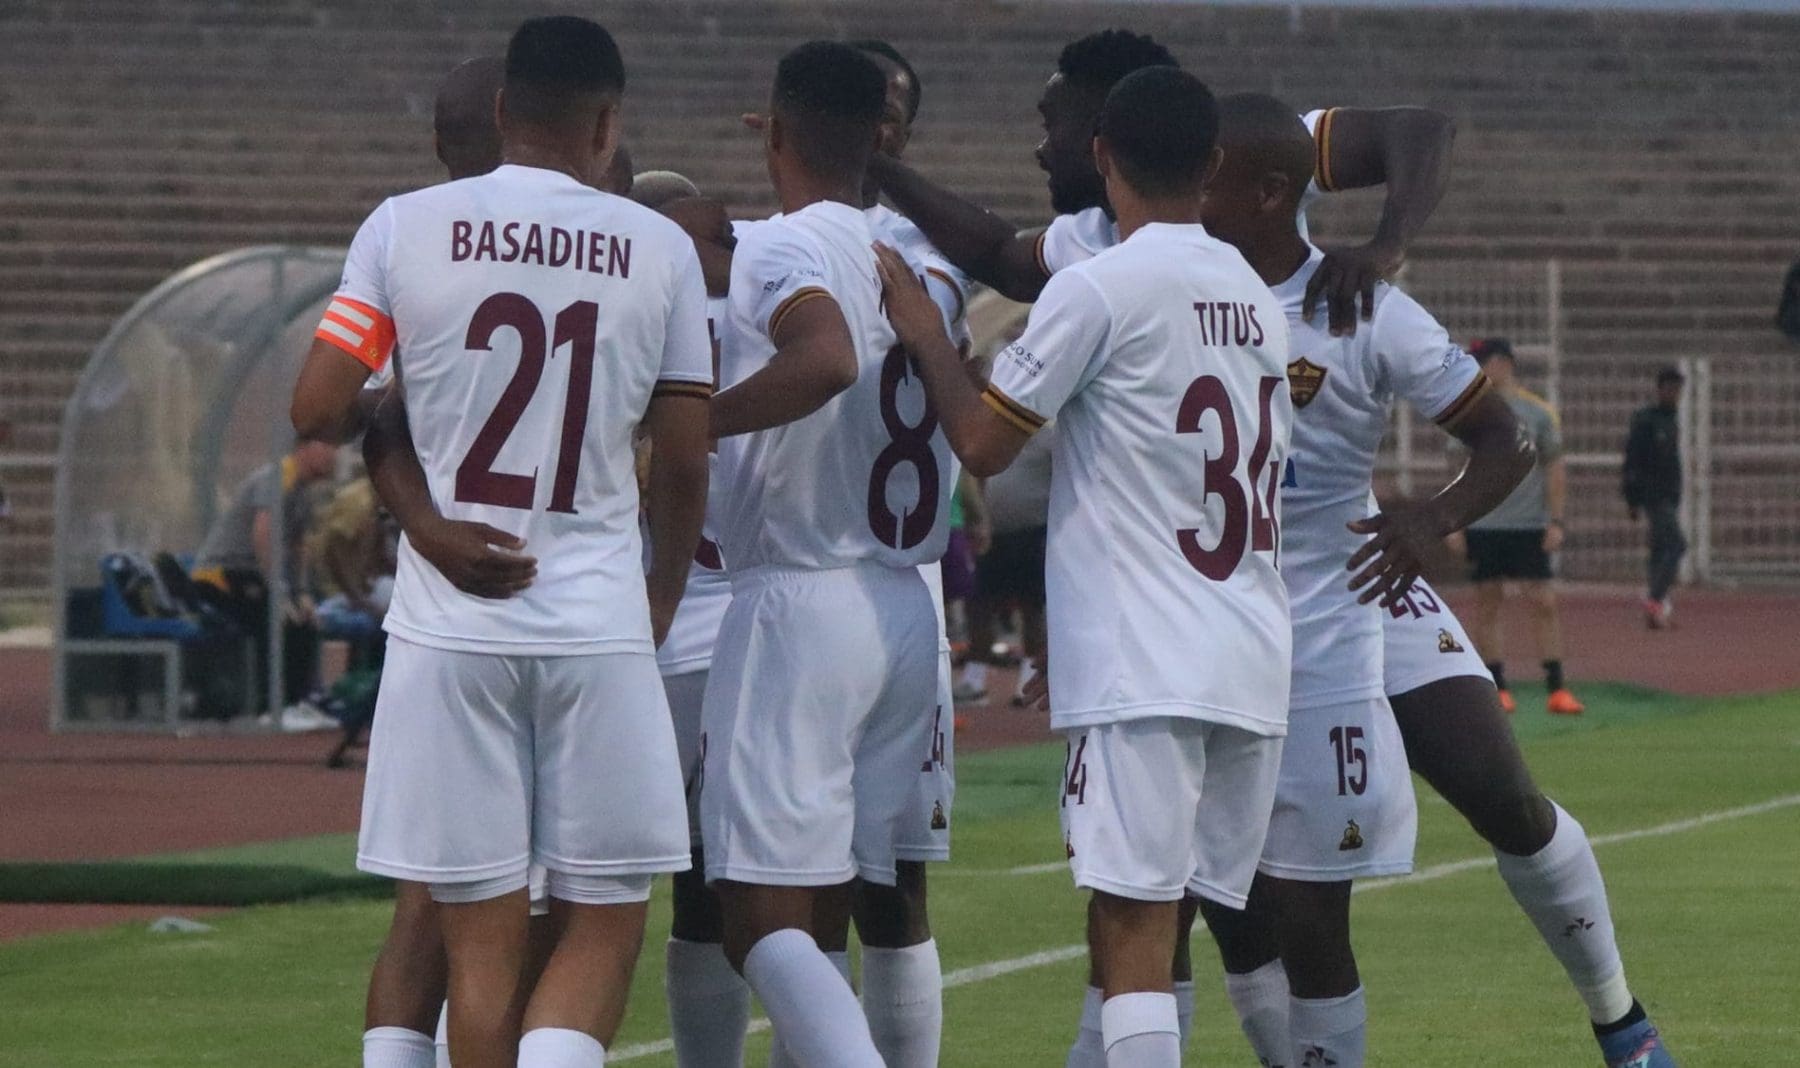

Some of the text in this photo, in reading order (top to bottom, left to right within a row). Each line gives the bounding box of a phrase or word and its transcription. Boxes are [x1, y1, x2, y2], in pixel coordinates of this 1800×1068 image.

[451, 220, 632, 279] BASADIEN
[1193, 301, 1265, 347] TITUS
[1025, 352, 1046, 371] SUN
[454, 291, 600, 515] 21
[867, 342, 940, 551] 8
[1175, 374, 1284, 582] 34
[1061, 735, 1087, 808] 4
[1328, 726, 1368, 796] 15
